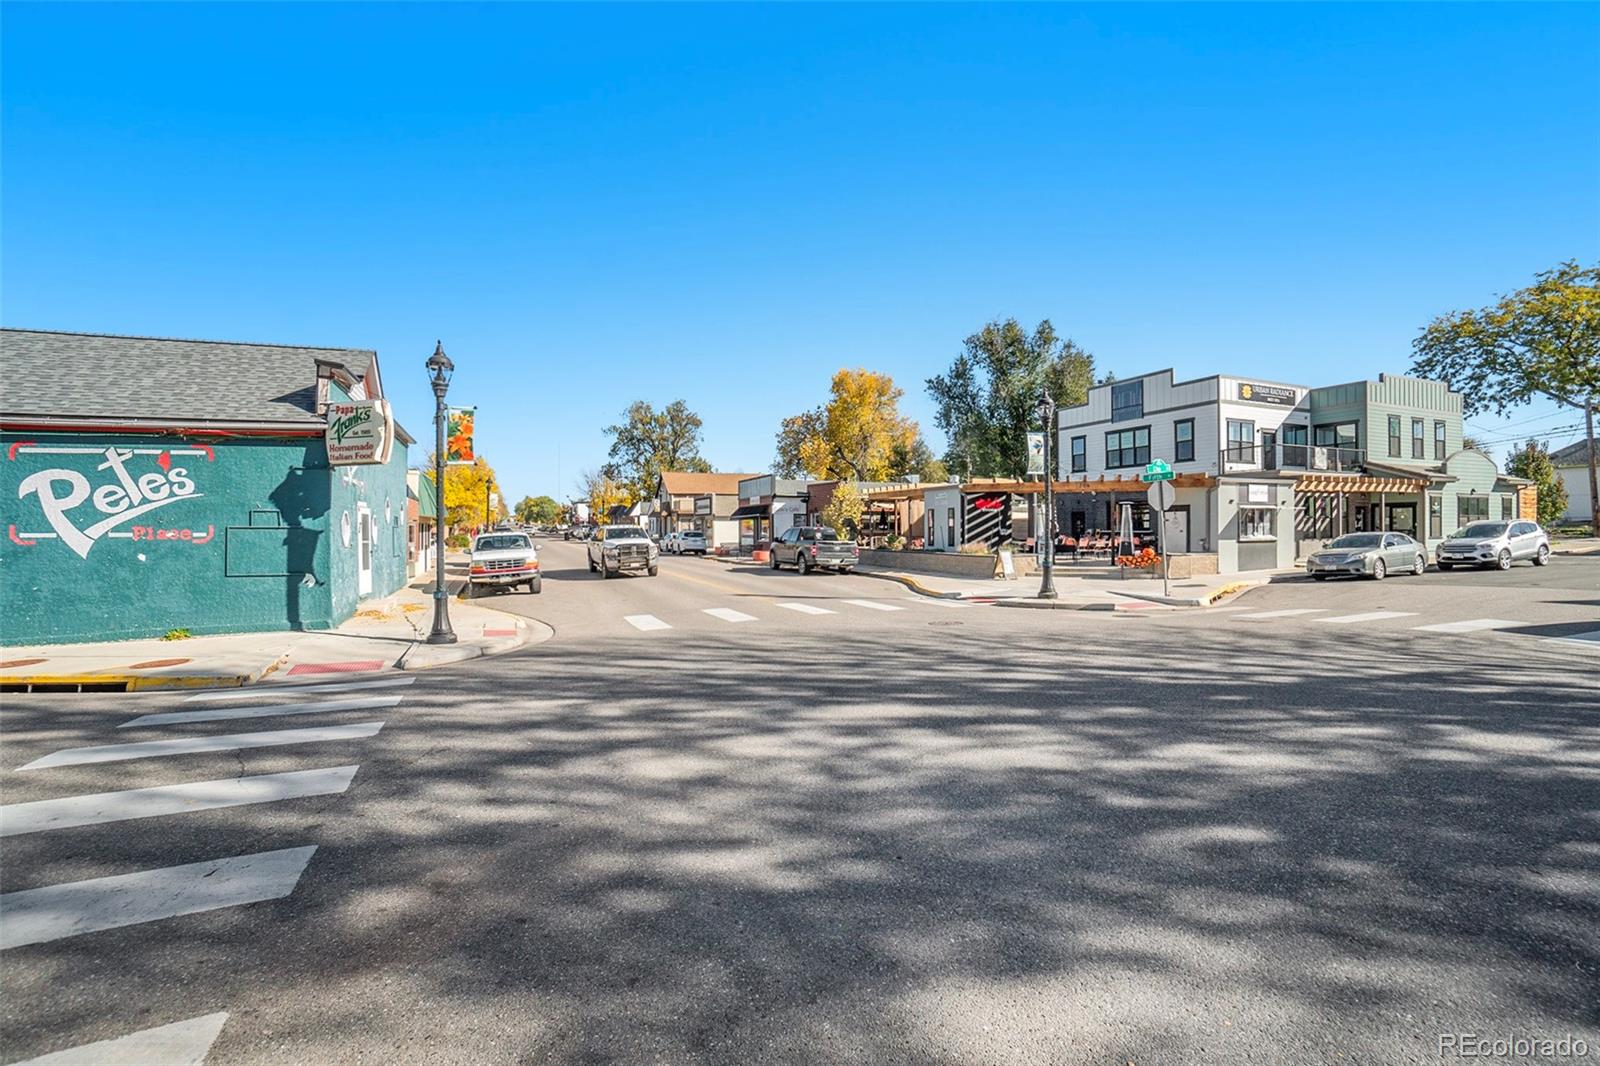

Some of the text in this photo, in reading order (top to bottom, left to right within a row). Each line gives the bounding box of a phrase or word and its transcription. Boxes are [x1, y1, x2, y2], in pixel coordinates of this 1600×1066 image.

[1252, 385, 1269, 394] URBAN
[336, 406, 354, 416] Papa
[329, 442, 374, 452] Homemade
[330, 452, 374, 461] Italian Food
[132, 526, 193, 542] Place
